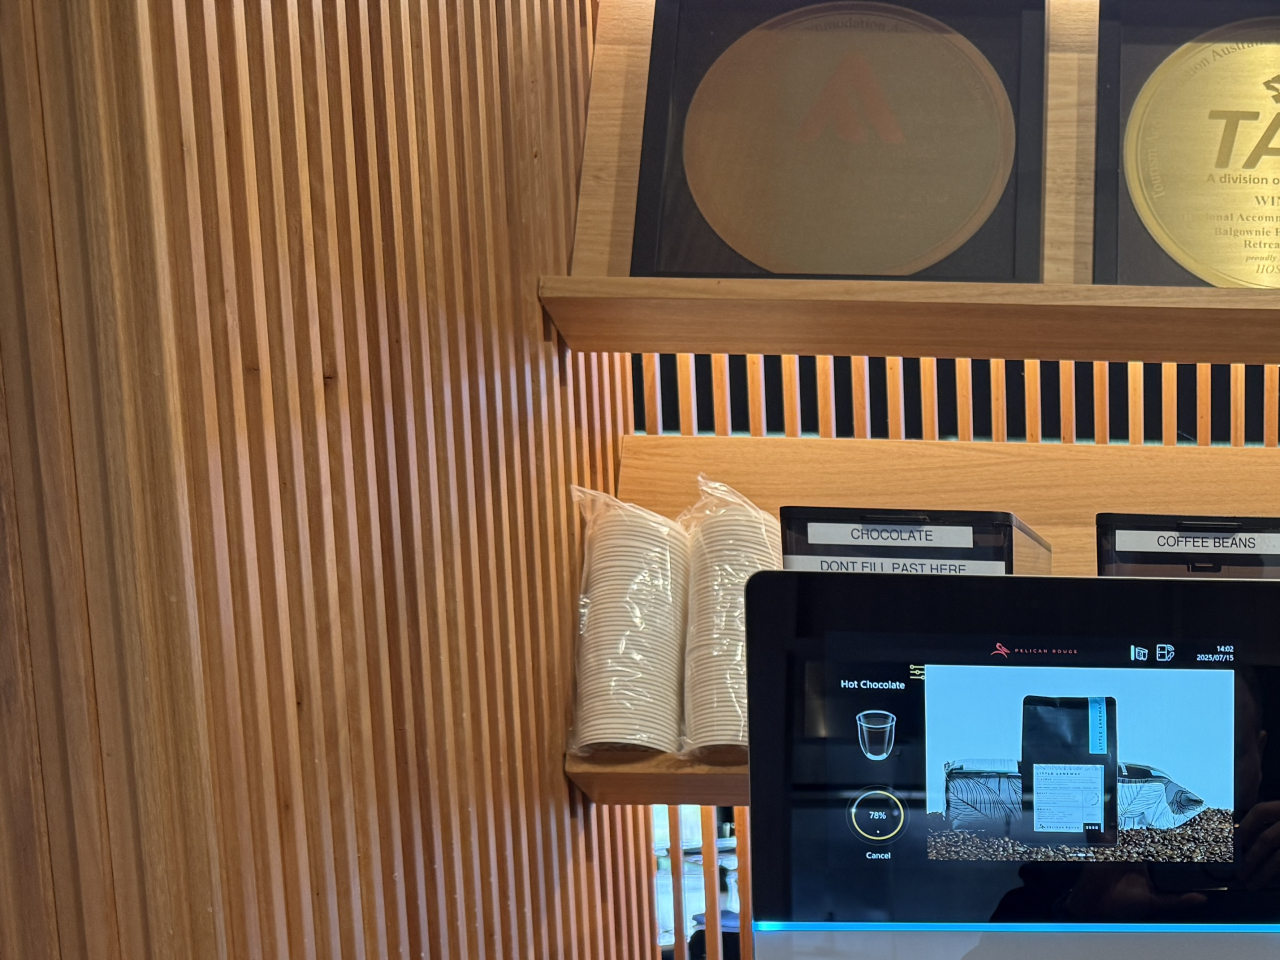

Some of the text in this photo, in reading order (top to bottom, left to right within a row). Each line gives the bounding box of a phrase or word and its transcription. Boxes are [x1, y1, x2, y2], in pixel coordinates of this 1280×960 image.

[1206, 173, 1216, 183] A
[1219, 173, 1269, 186] division
[1214, 227, 1272, 239] Balgownie
[1245, 254, 1277, 263] proudly
[850, 528, 933, 542] CHOCOLATE
[1157, 536, 1256, 549] COFFEE BEANS
[820, 560, 858, 571] DONT
[892, 563, 927, 573] PAST
[930, 563, 967, 574] HERE
[1216, 645, 1234, 653] 14:02
[1196, 653, 1234, 662] 2025/07/15
[840, 680, 906, 690] Hot Chocolate
[868, 811, 887, 820] 78%
[866, 851, 891, 860] Cancel
